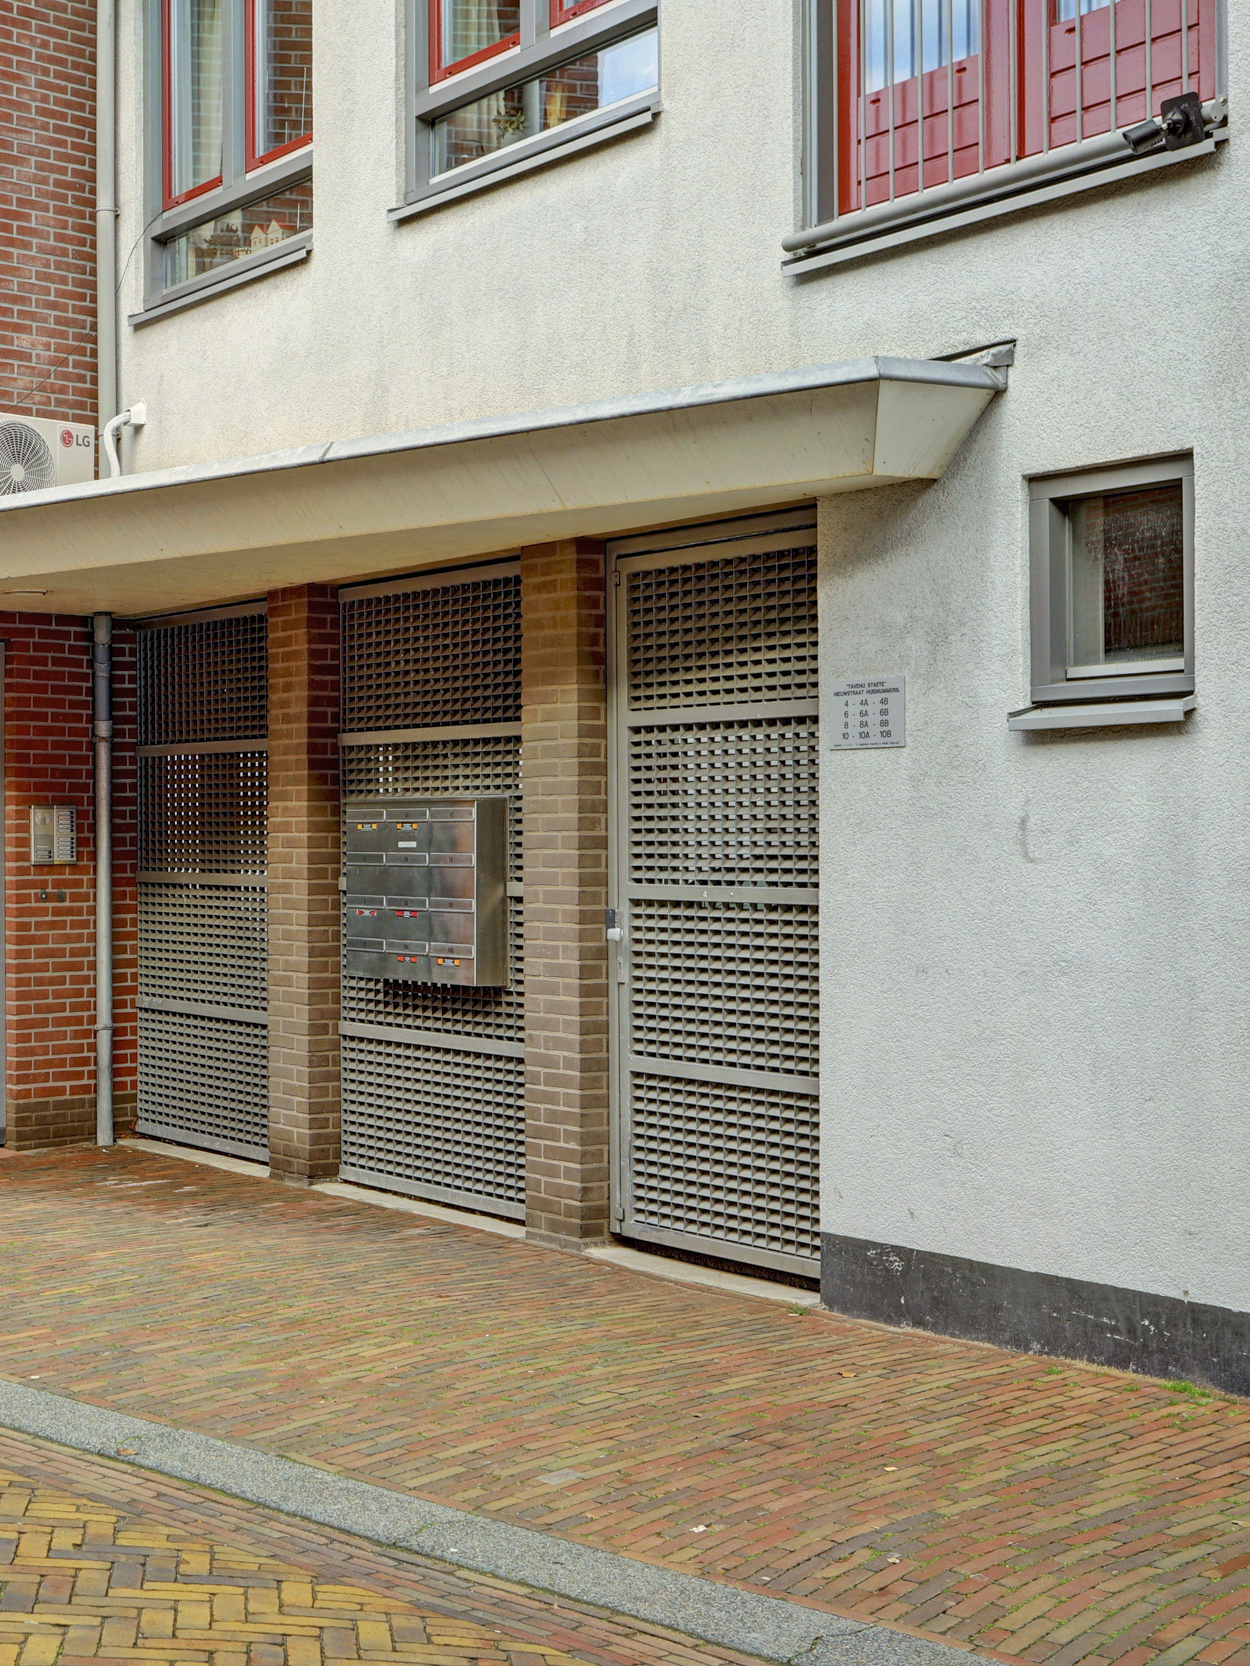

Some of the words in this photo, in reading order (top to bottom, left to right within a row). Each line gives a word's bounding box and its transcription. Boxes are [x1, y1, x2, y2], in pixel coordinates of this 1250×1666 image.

[76, 434, 90, 447] LG
[879, 697, 889, 705] 4B
[880, 708, 889, 716] 6B
[842, 732, 849, 740] 10
[858, 731, 870, 739] 10A
[880, 730, 892, 738] 10B
